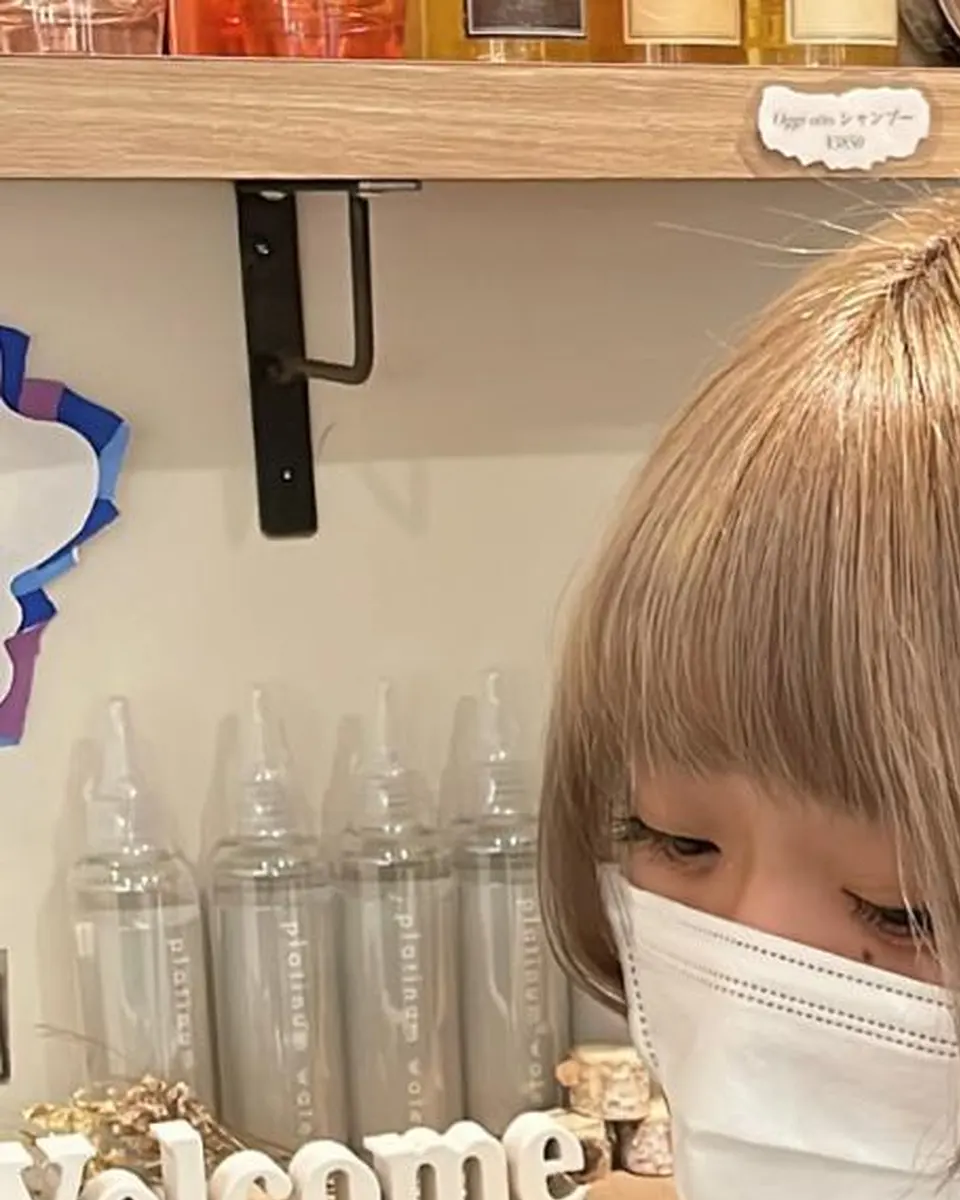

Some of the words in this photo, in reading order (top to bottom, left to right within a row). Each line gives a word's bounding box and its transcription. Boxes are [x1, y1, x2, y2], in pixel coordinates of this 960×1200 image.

[840, 108, 914, 127] シャンプー
